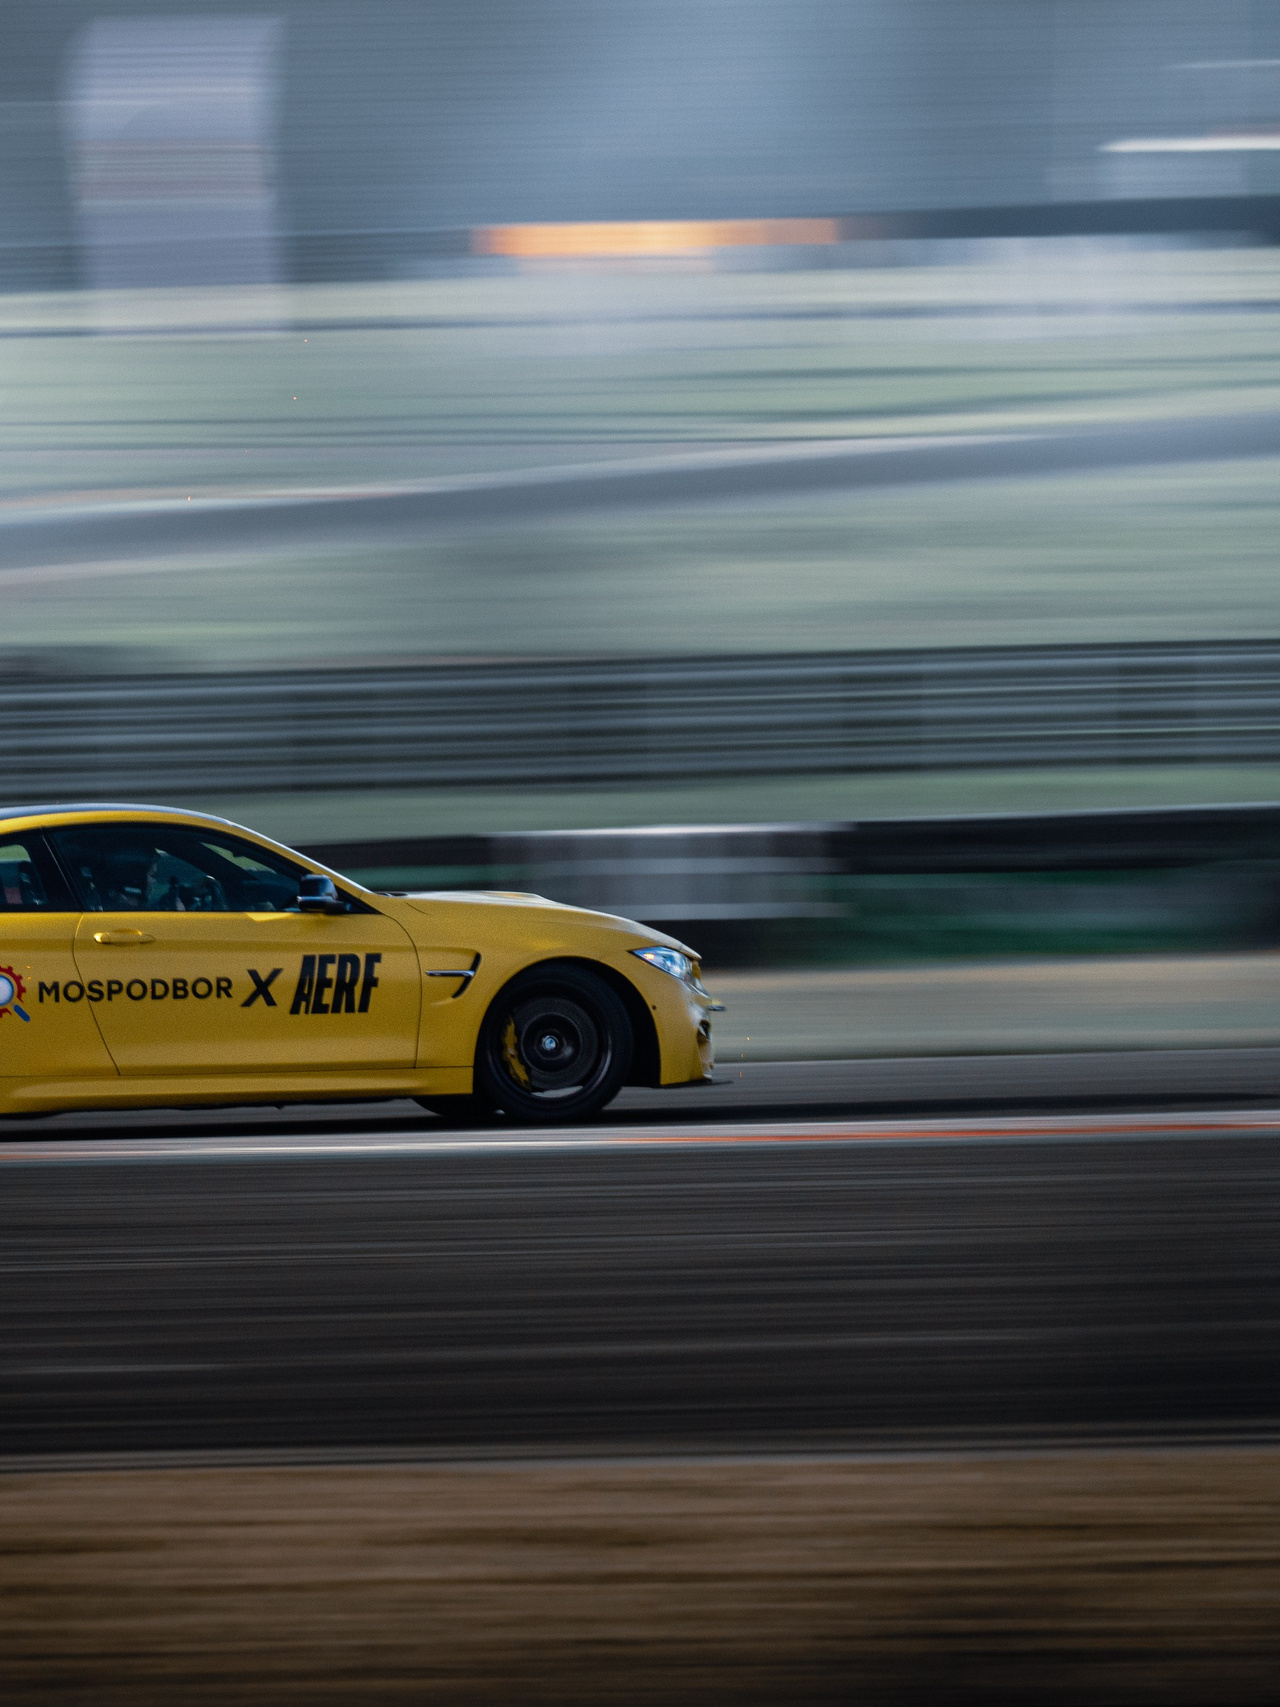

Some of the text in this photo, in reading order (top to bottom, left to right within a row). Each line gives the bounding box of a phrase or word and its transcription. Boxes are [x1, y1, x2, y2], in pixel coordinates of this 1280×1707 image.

[38, 952, 382, 1015] MOSPODBOR X AERF
